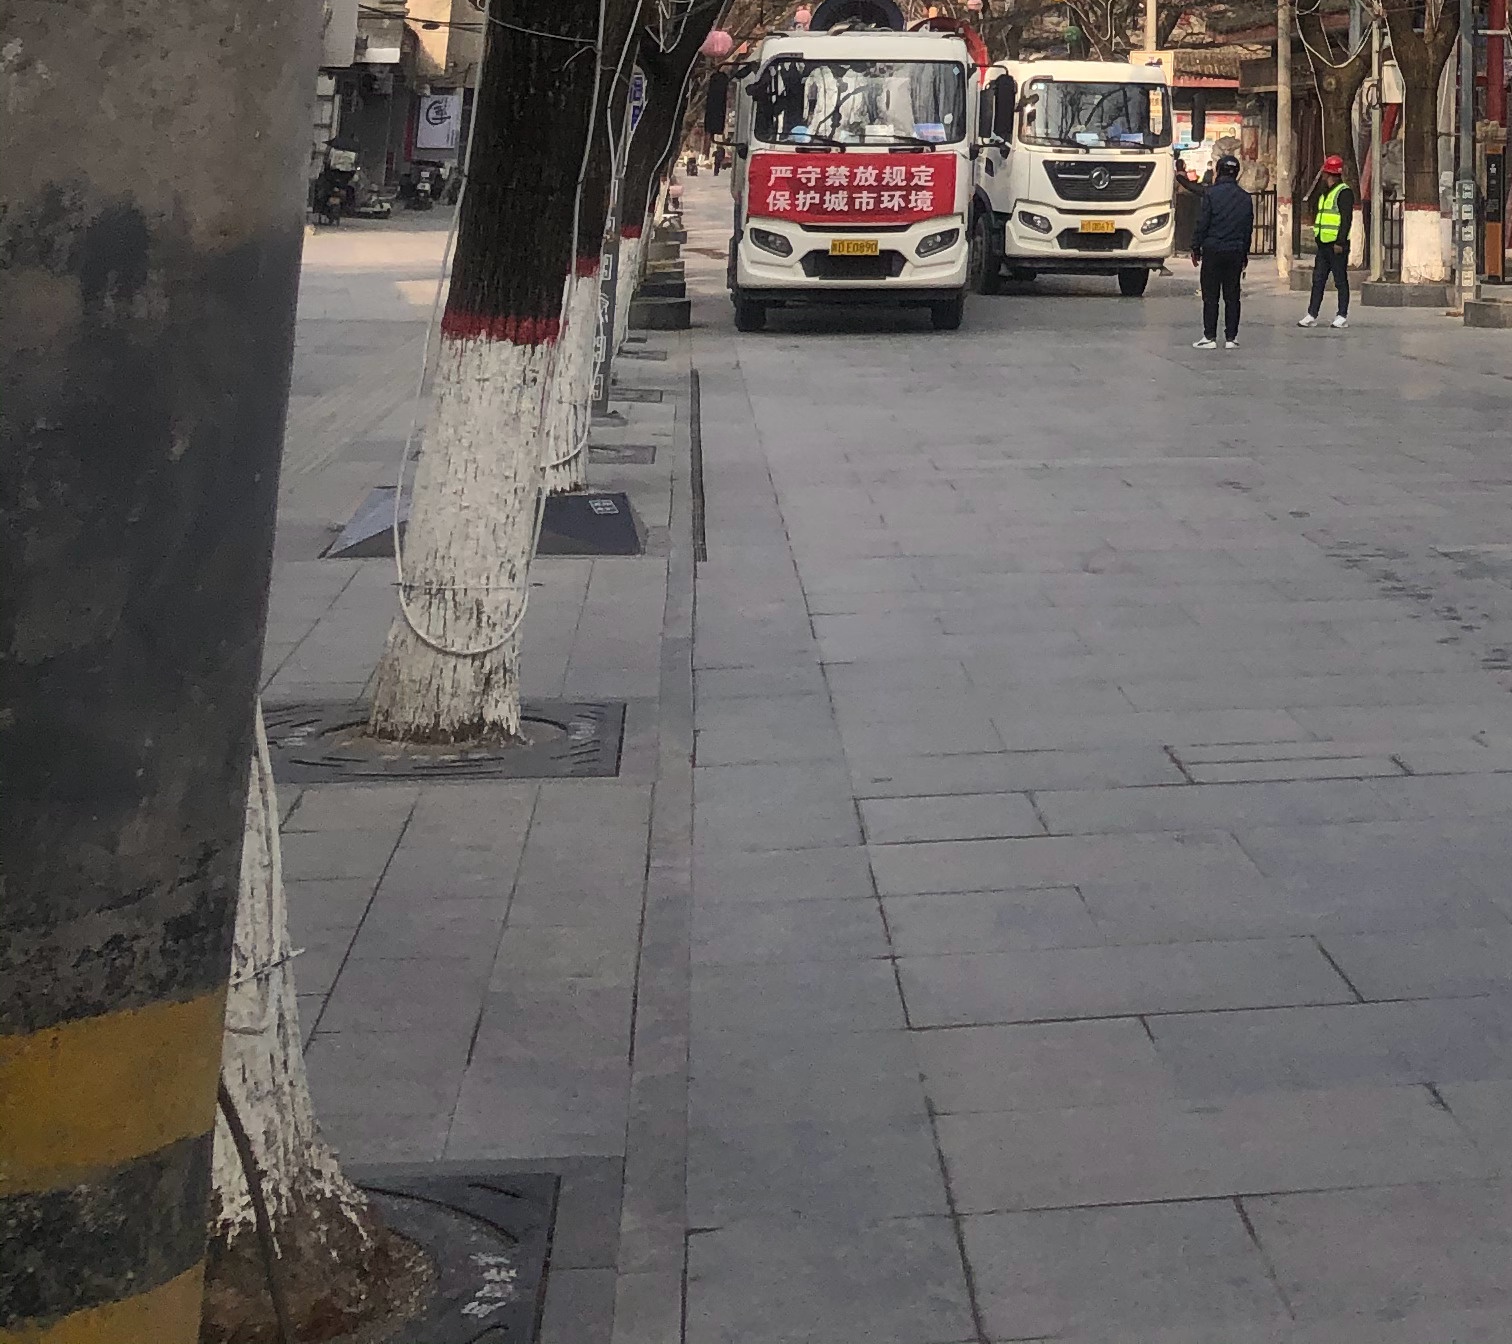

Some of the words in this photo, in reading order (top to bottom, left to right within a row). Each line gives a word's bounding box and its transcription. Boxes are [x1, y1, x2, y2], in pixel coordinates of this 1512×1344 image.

[767, 165, 936, 188] 严守禁放规定
[765, 189, 935, 213] 保护城市环境
